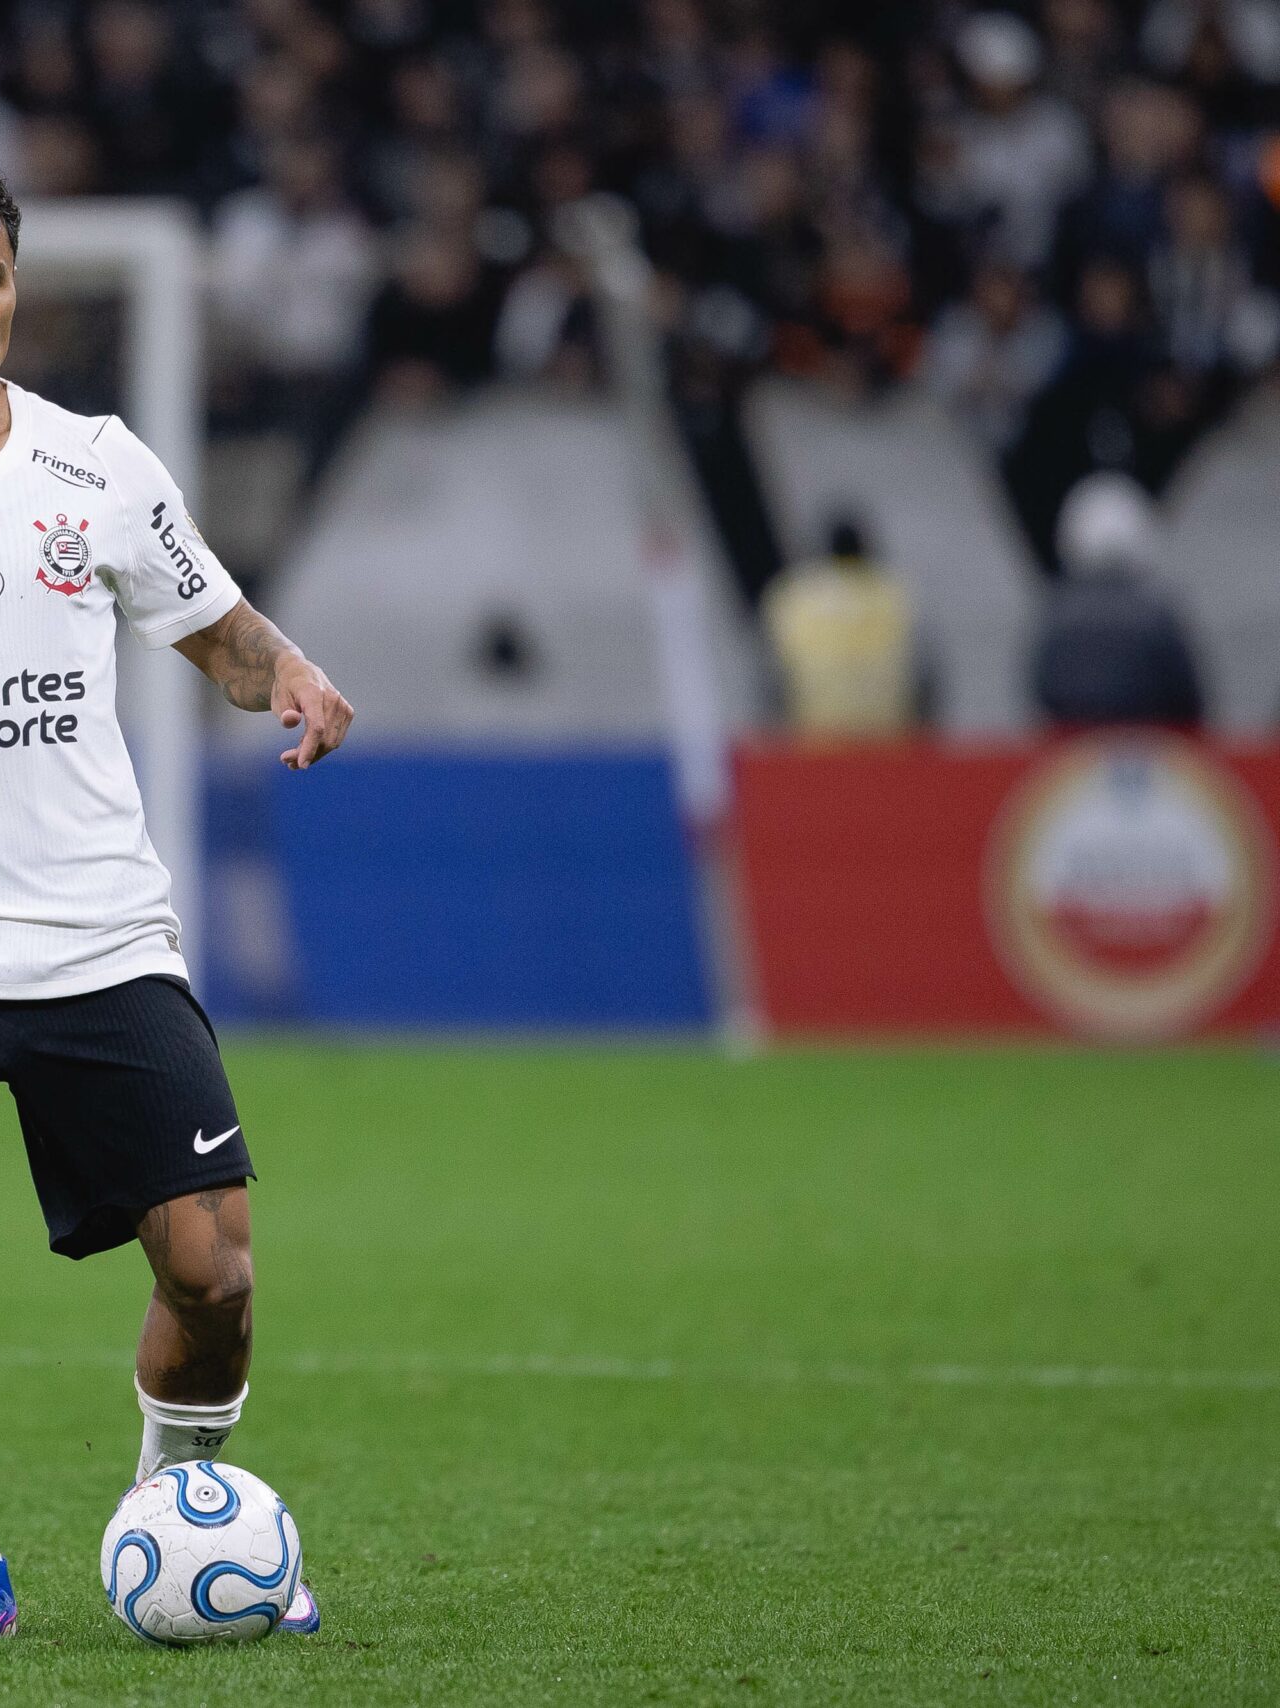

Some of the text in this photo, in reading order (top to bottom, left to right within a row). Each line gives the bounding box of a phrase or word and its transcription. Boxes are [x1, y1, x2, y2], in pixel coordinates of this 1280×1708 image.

[32, 449, 107, 491] Frimesa
[159, 522, 207, 600] bmg
[181, 539, 205, 570] banco
